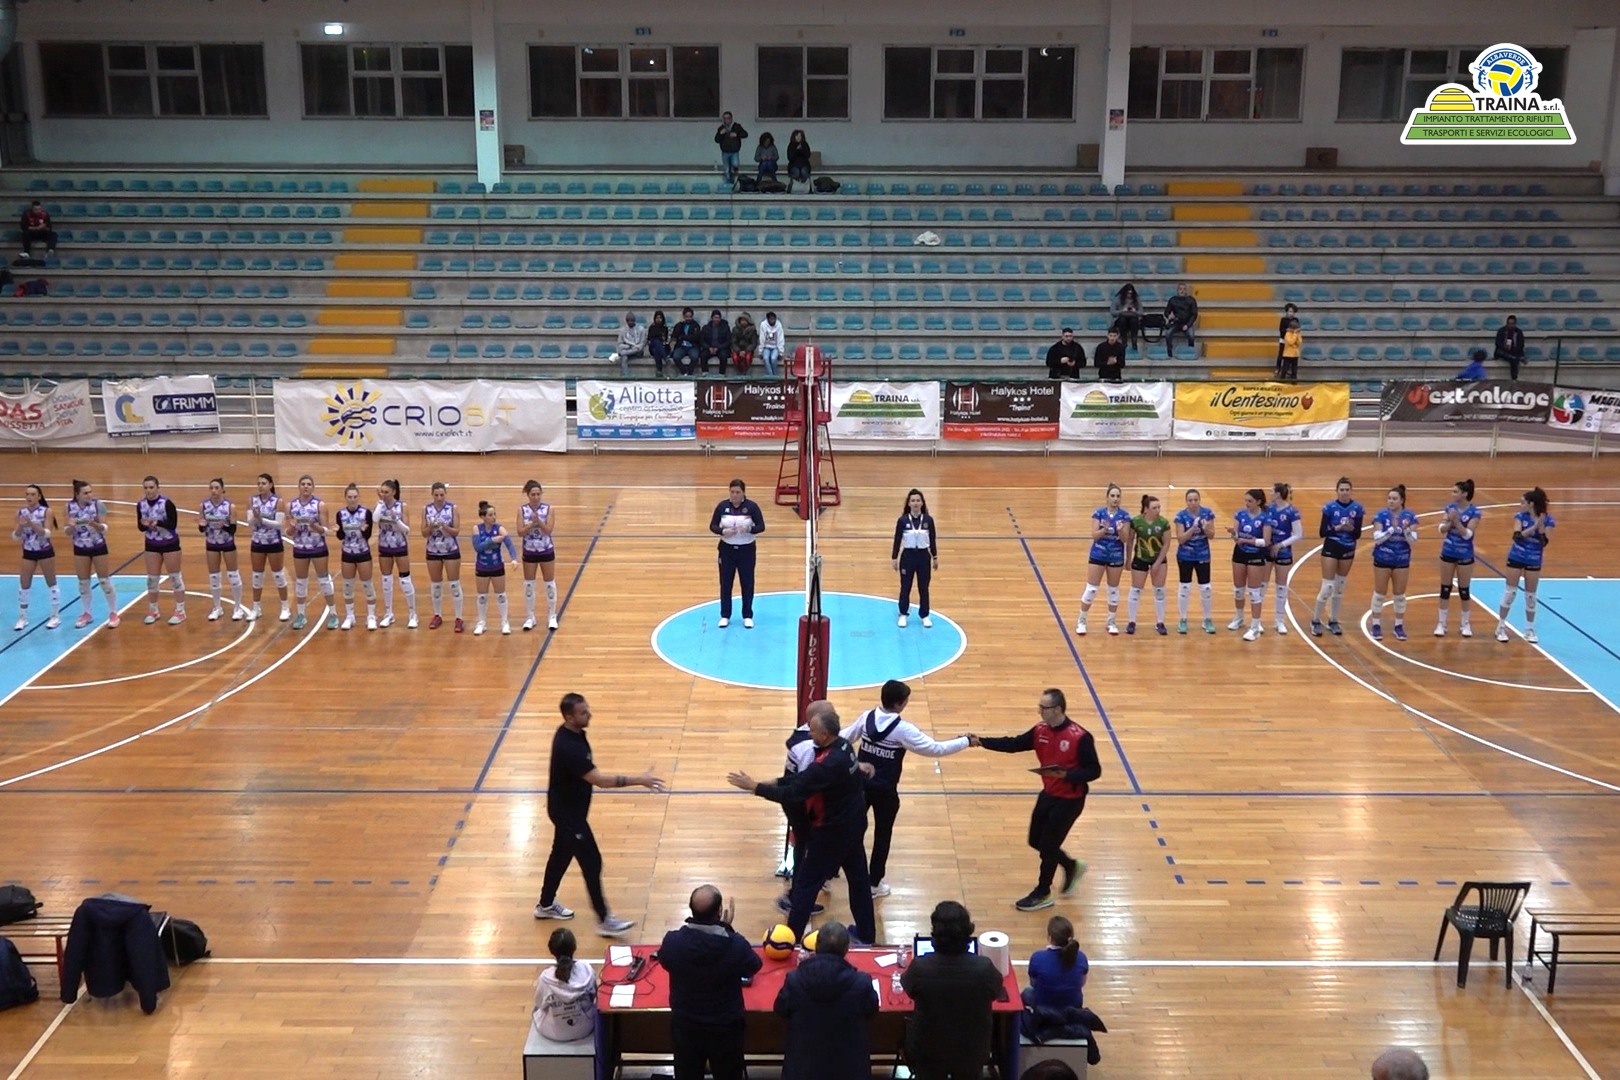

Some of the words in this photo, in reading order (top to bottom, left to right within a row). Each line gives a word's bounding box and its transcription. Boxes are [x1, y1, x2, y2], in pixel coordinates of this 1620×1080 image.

[619, 386, 682, 404] Aliotta
[744, 385, 781, 396] Halykos
[991, 387, 1027, 396] Halykos
[1030, 386, 1054, 395] Hotel
[1210, 392, 1222, 407] il
[1221, 386, 1300, 408] Centesimo
[1429, 386, 1550, 410] extralarge
[172, 397, 215, 410] FRIMM
[1109, 395, 1143, 403] TRAINA
[861, 741, 896, 759] LBAVERDE
